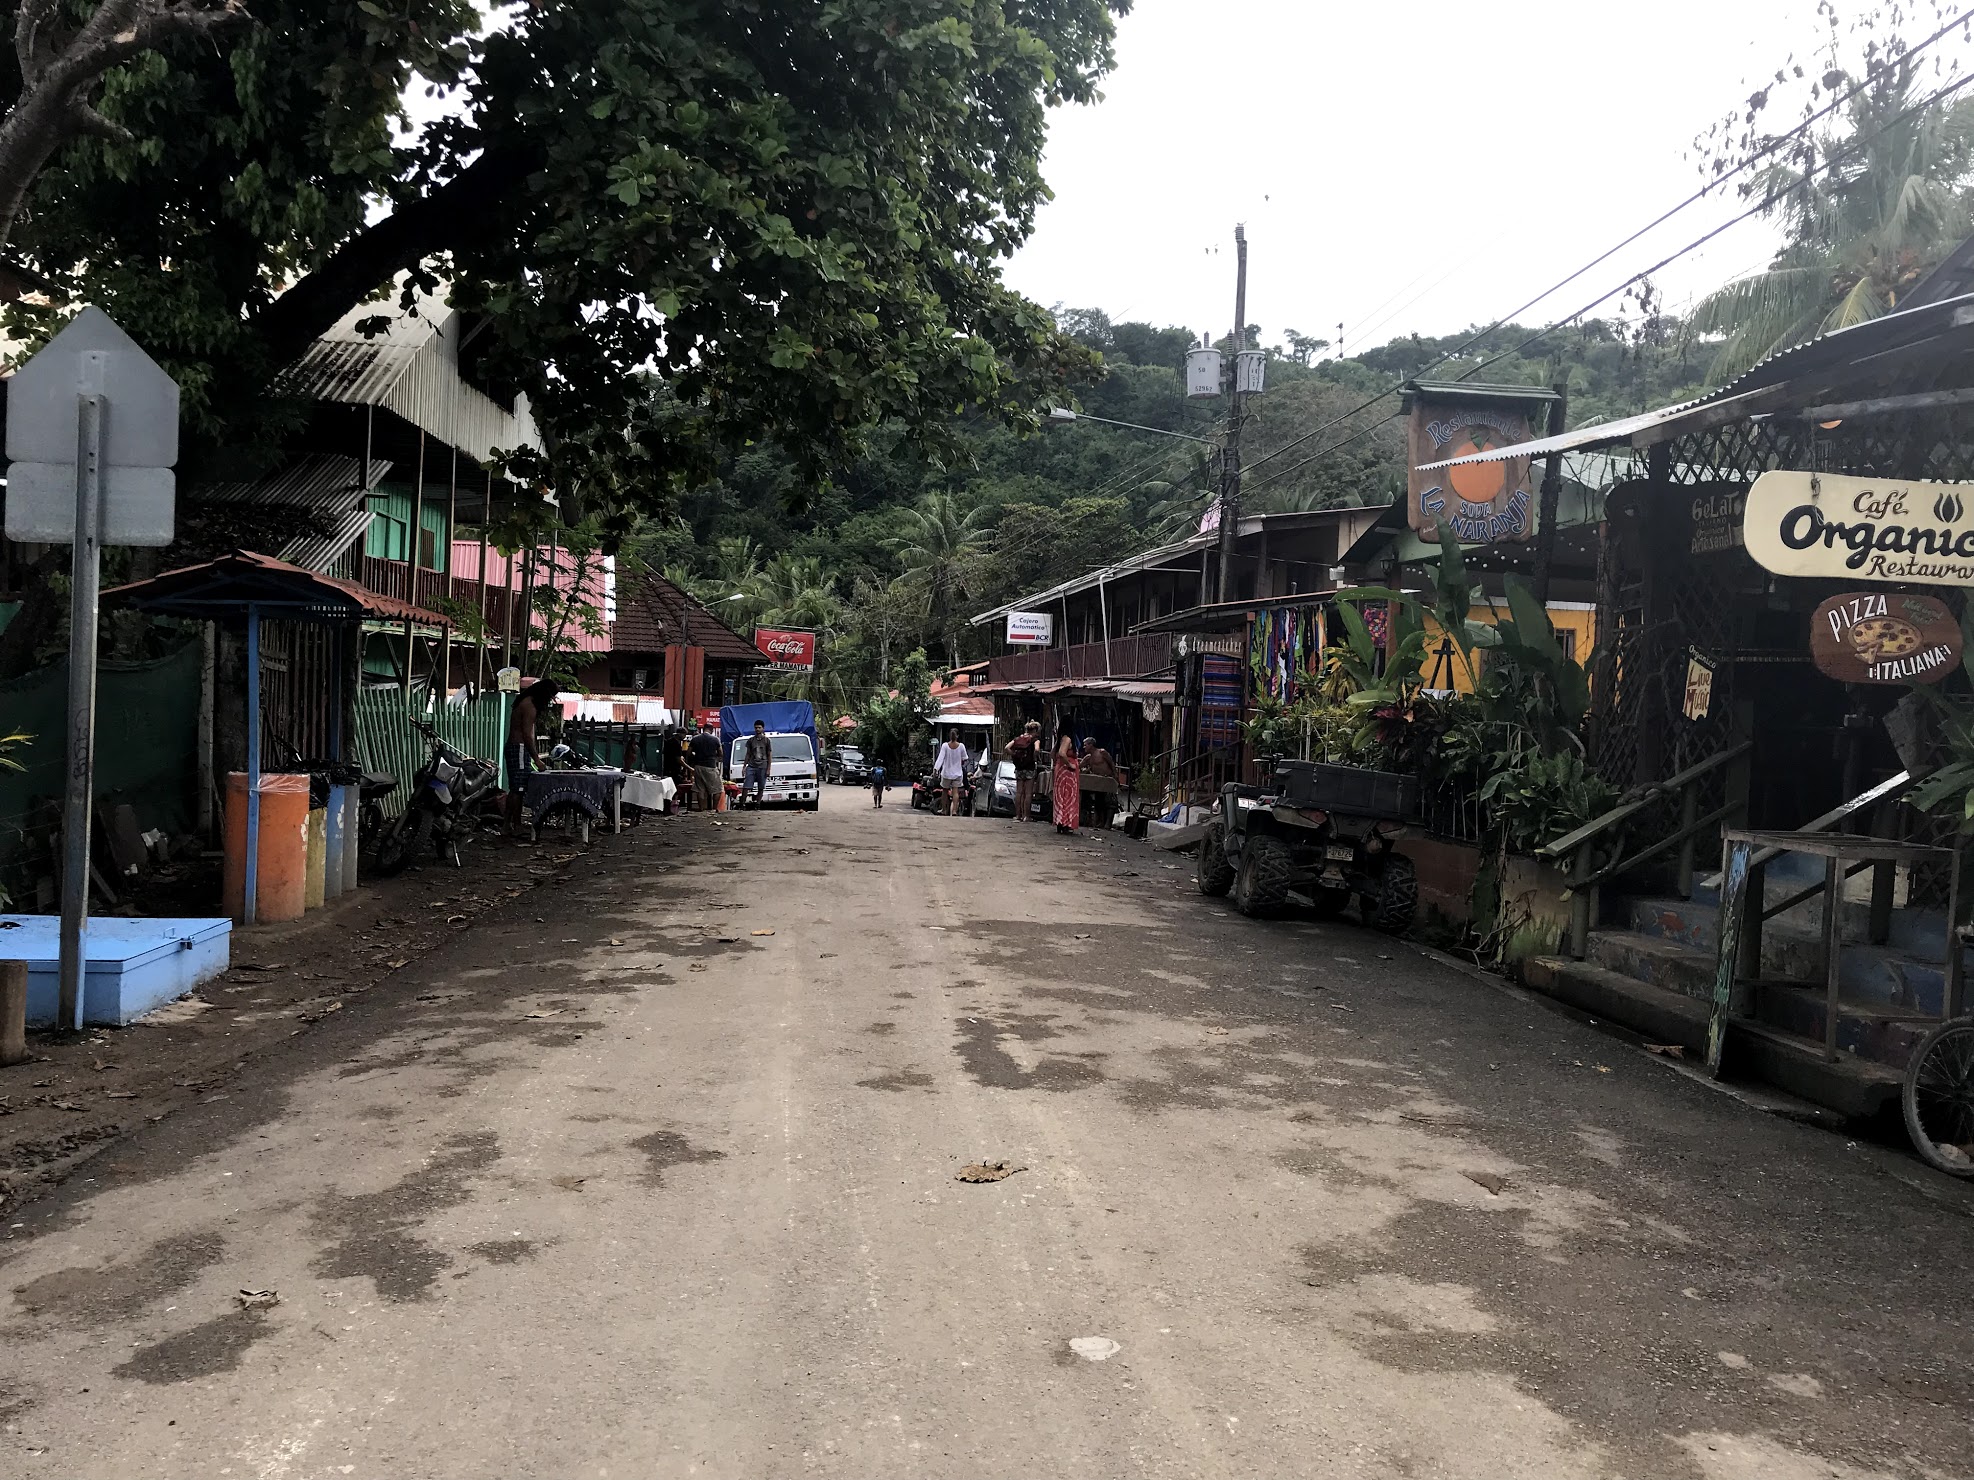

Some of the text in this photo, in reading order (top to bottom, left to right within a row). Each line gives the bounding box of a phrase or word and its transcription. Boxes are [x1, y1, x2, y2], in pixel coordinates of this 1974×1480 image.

[1425, 410, 1521, 450] Restaurante
[1449, 489, 1531, 542] NARANJA
[1460, 500, 1492, 518] SODA
[1853, 487, 1909, 520] Café
[1866, 555, 1974, 580] Restaura
[1019, 617, 1039, 625] Cajero
[1828, 594, 1888, 643] PIZZA
[1688, 644, 1717, 669] Organico
[1687, 664, 1711, 689] Live
